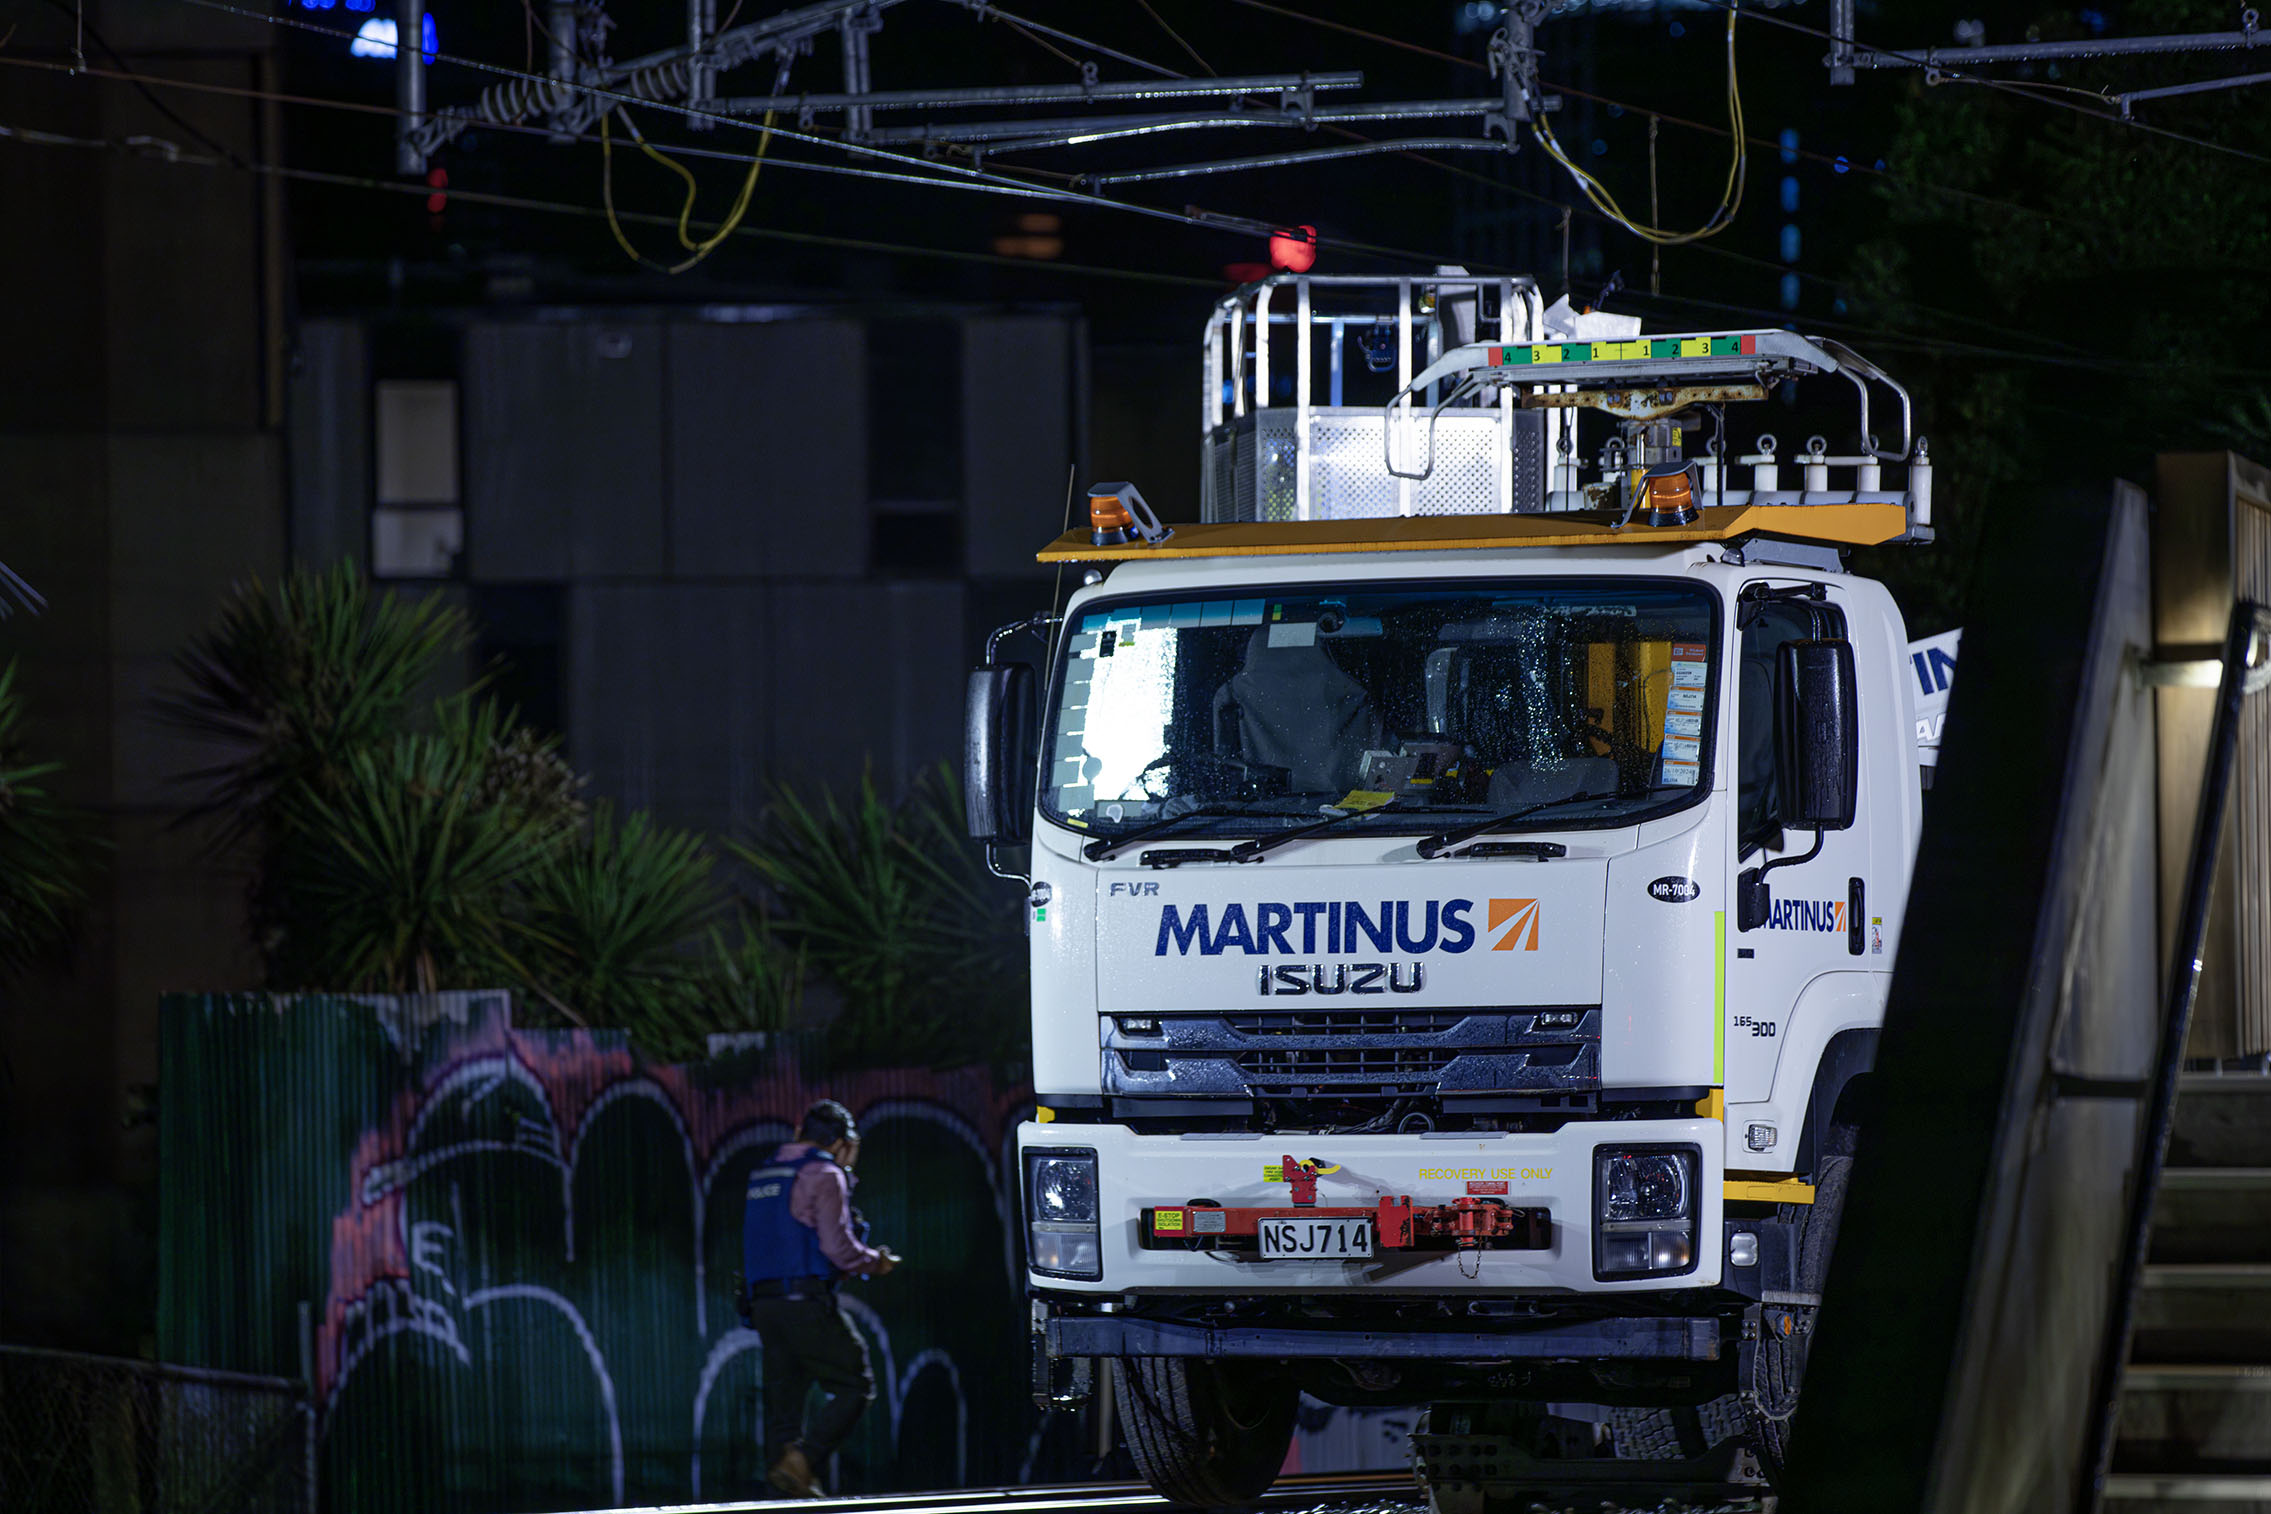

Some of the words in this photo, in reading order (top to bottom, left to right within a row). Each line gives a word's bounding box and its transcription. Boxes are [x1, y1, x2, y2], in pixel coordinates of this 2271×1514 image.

[1504, 352, 1511, 362] 4
[1533, 351, 1540, 361] 3
[1563, 349, 1570, 360] 2
[1593, 348, 1599, 358] 1
[1643, 345, 1650, 356] 1
[1672, 344, 1679, 355] 2
[1702, 342, 1709, 353] 3
[1731, 341, 1739, 352] 4
[1110, 882, 1160, 896] FVR
[1653, 884, 1695, 896] MR-7004
[1155, 899, 1476, 956] MARTINUS
[1258, 962, 1424, 996] ISUZU
[1734, 1016, 1752, 1027] 165
[1752, 1022, 1776, 1037] 300
[1419, 1168, 1486, 1180] RECOVERY
[1491, 1168, 1516, 1179] USE
[1520, 1168, 1553, 1179] ONLY
[1264, 1224, 1368, 1253] NSJ714
